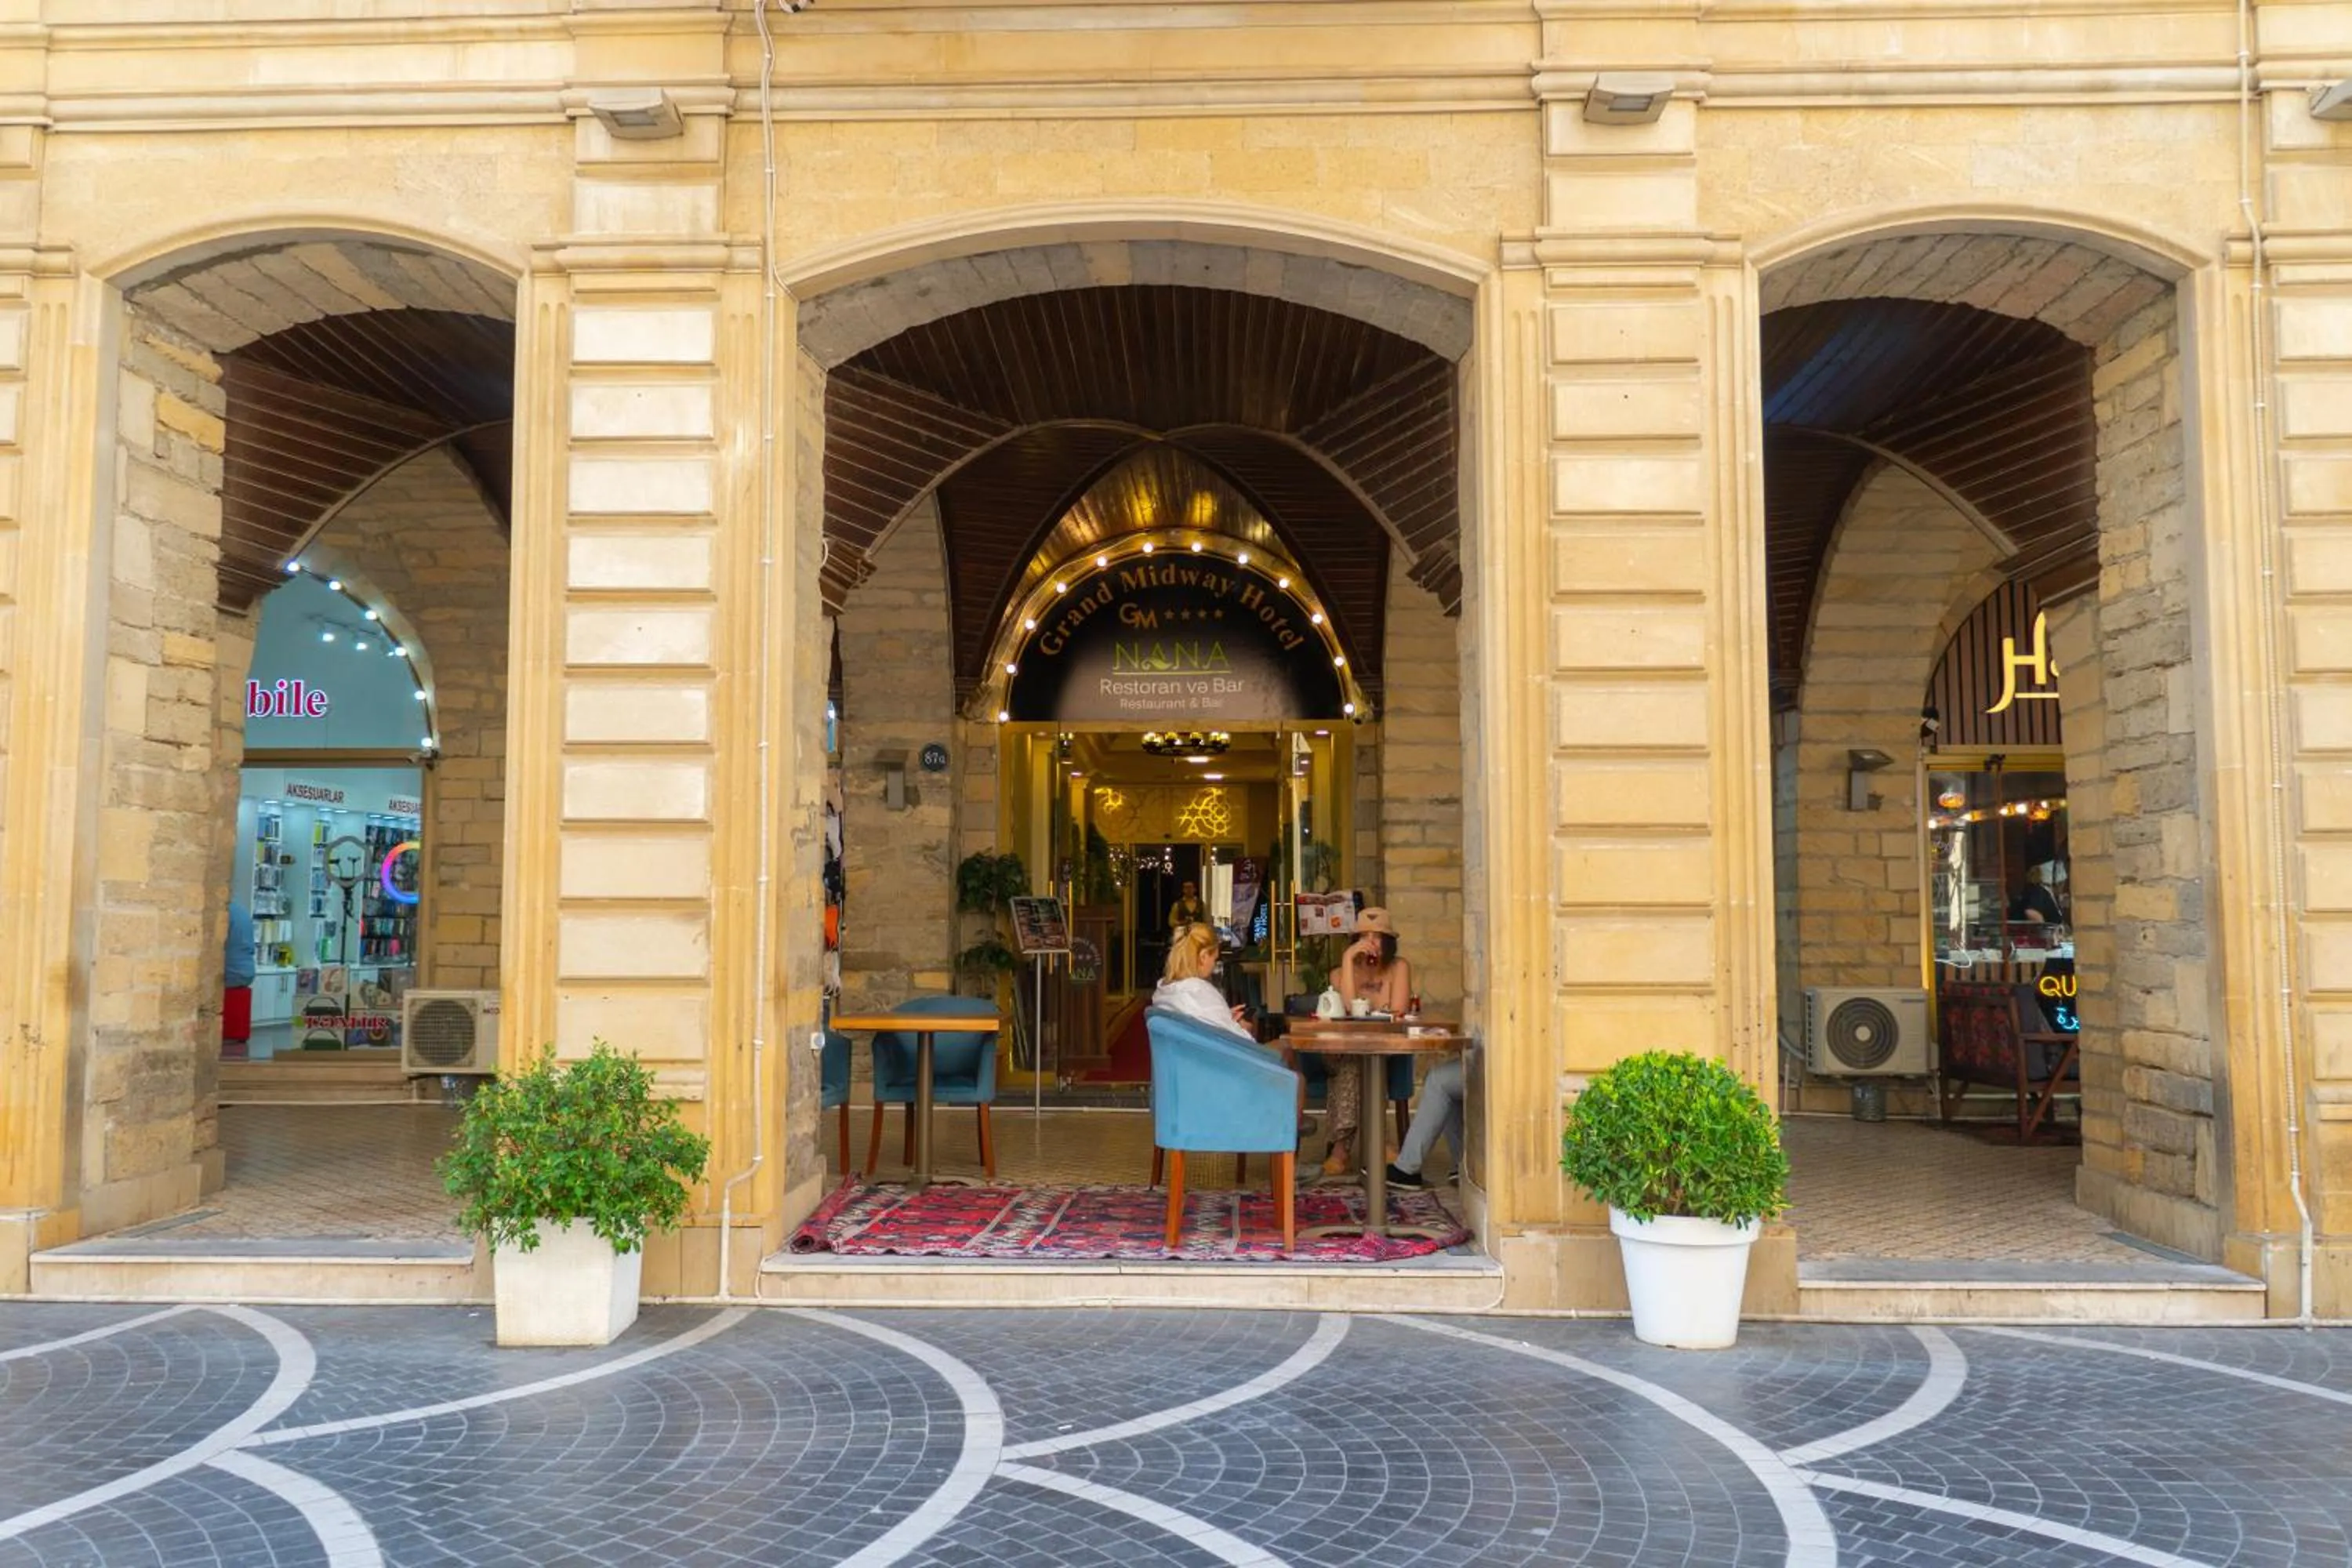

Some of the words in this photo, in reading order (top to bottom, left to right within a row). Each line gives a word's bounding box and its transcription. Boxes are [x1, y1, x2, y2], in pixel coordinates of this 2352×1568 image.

[1040, 581, 1113, 655] Grand
[1120, 564, 1236, 597] Midway
[1240, 583, 1305, 651] Hotel
[1112, 641, 1230, 670] NANA
[246, 679, 328, 717] bile
[1100, 678, 1180, 695] Restoran
[1186, 681, 1208, 694] və
[1213, 677, 1244, 693] Bar
[1120, 698, 1185, 710] Restaurant
[1189, 697, 1199, 709] &
[1202, 696, 1224, 708] Bar
